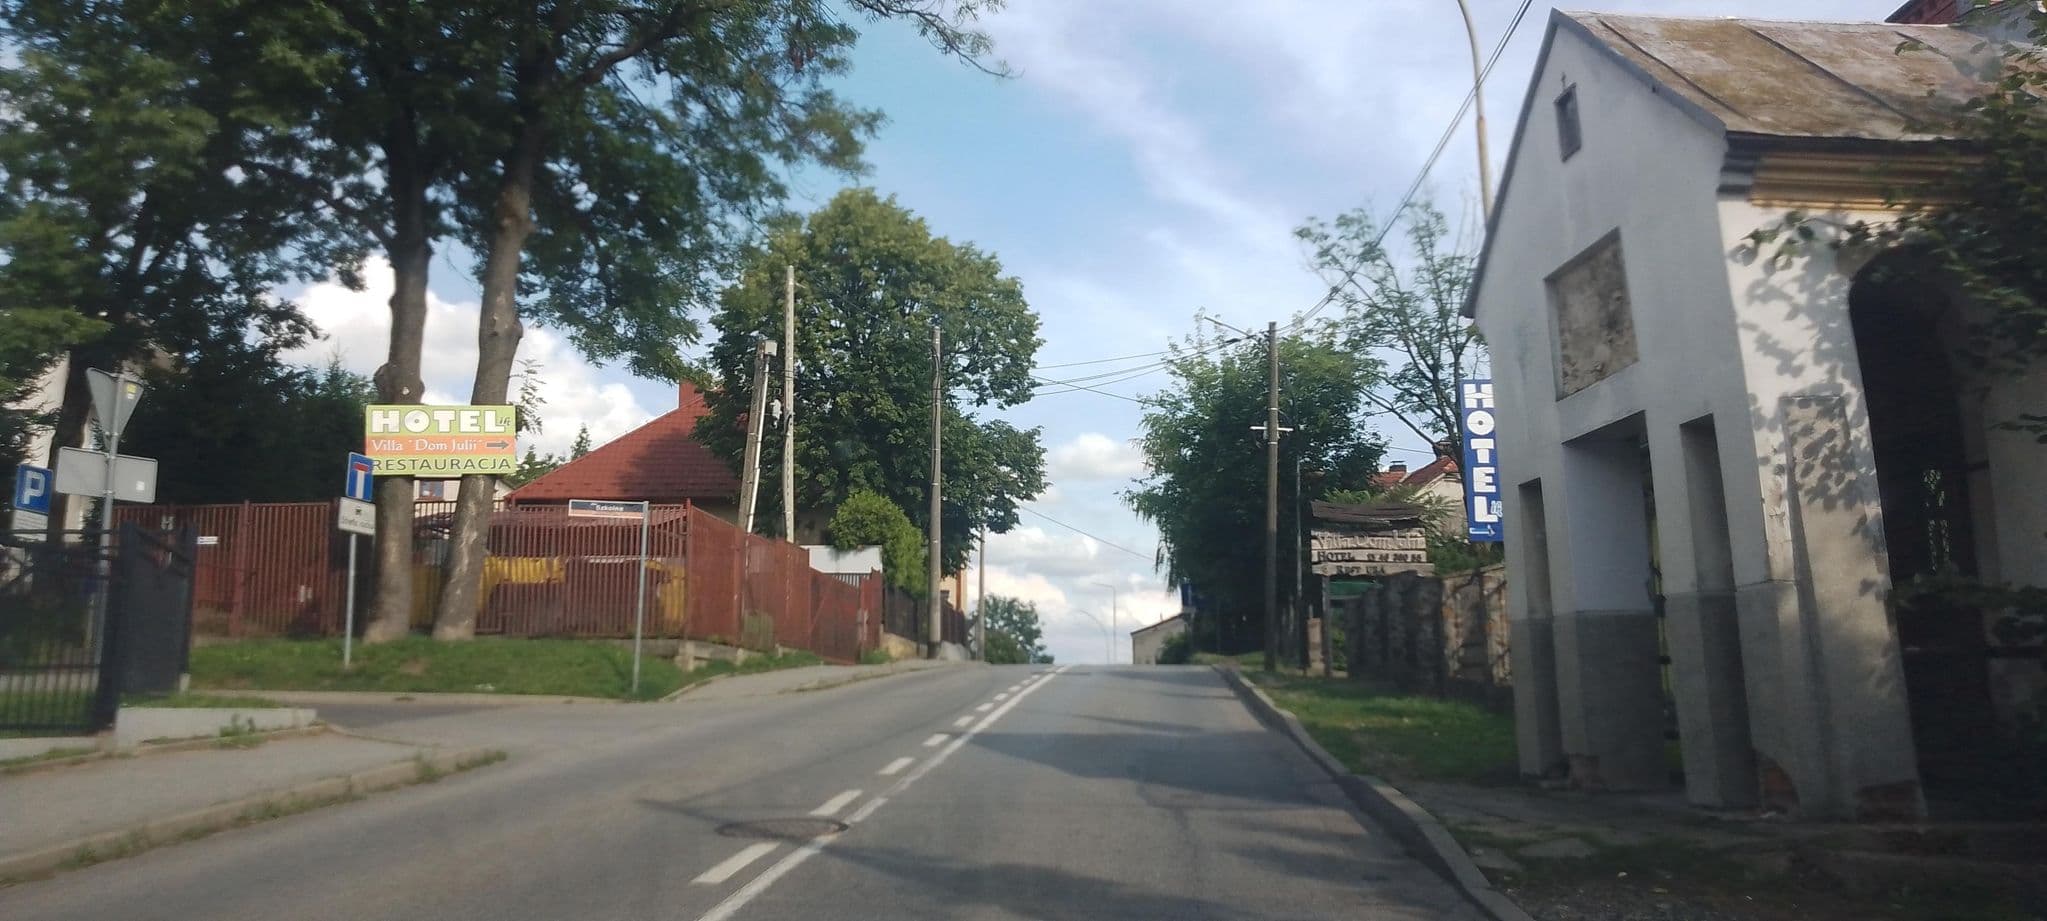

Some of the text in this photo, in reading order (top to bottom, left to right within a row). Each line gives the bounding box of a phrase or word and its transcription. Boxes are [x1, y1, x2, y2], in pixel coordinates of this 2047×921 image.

[371, 409, 506, 433] HOTEL
[372, 439, 403, 451] Villa
[1463, 383, 1498, 522] HOTEL
[373, 458, 511, 471] RESTAURACJA
[23, 470, 46, 505] P
[1318, 551, 1355, 561] HOTEL
